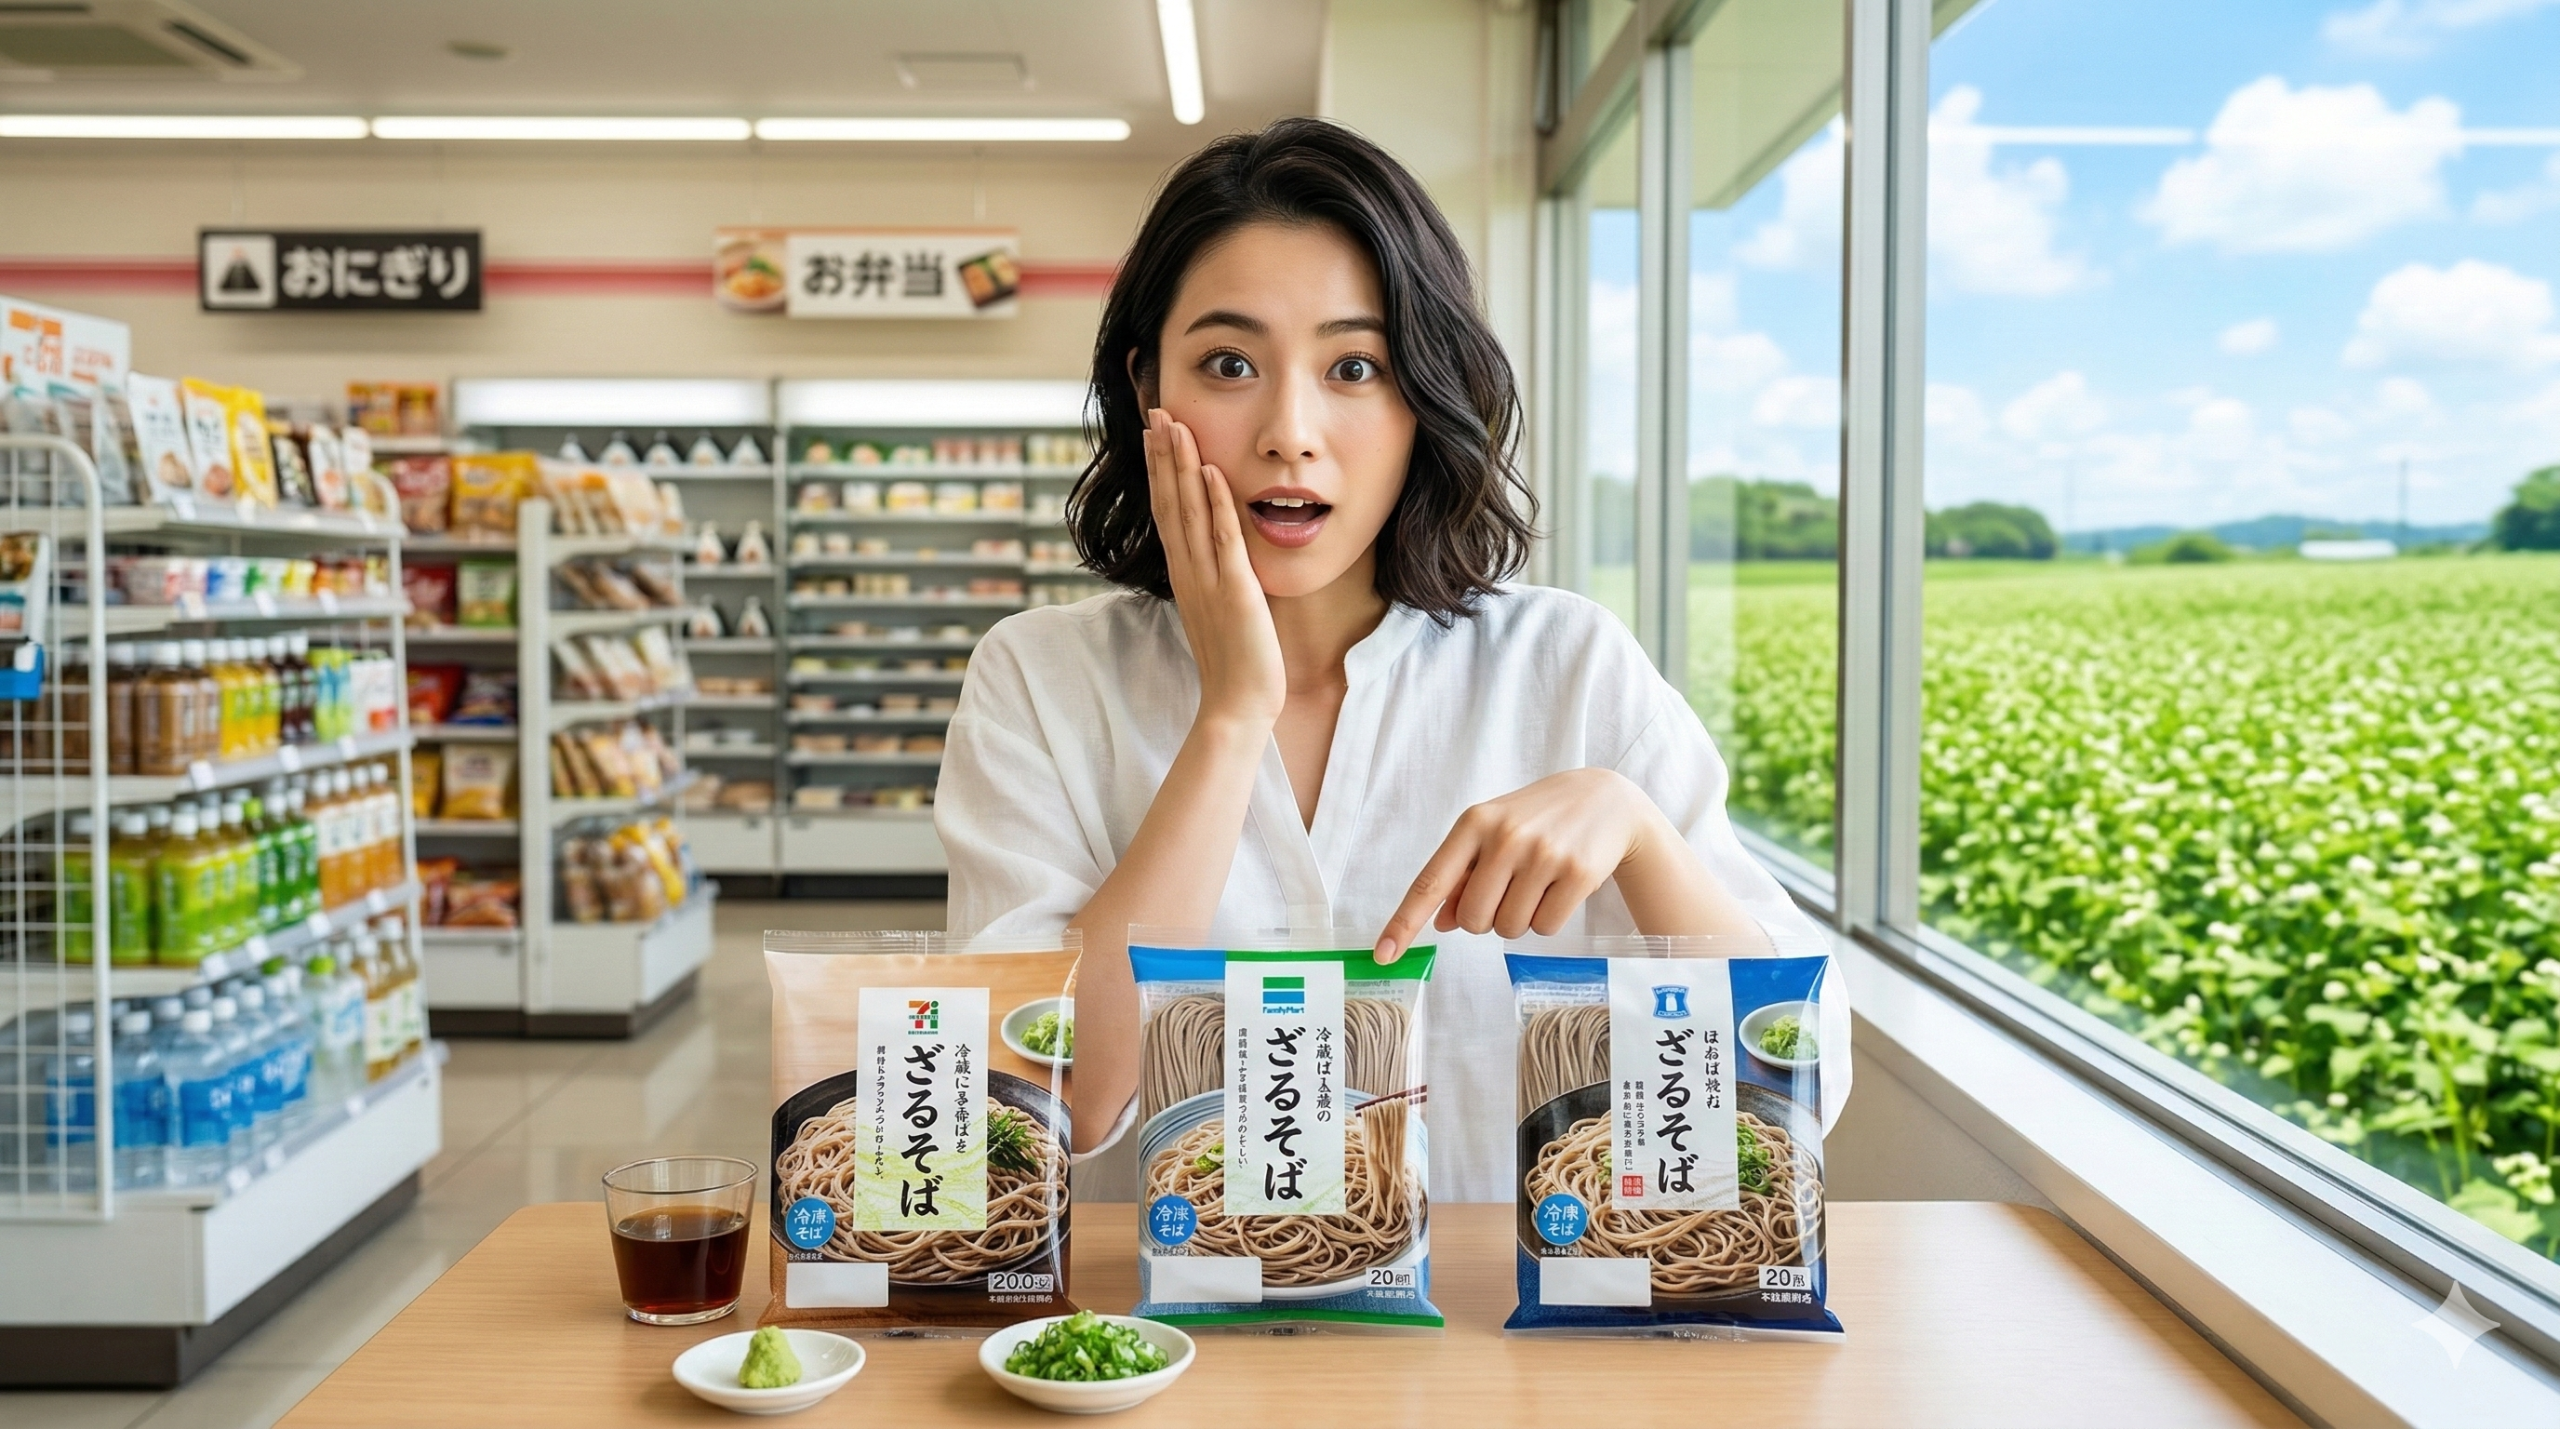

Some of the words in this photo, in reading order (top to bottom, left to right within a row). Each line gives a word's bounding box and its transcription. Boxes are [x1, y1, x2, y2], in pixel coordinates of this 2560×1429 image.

[282, 245, 470, 298] おにぎり
[803, 251, 943, 297] お弁当
[1263, 1006, 1305, 1015] FamilyMart
[901, 1043, 945, 1218] ざるそば
[1264, 1027, 1307, 1201] ざるそば
[1656, 1029, 1699, 1194] ざるそば
[796, 1227, 823, 1240] そば
[1159, 1223, 1185, 1237] そば
[1547, 1223, 1575, 1237] そば
